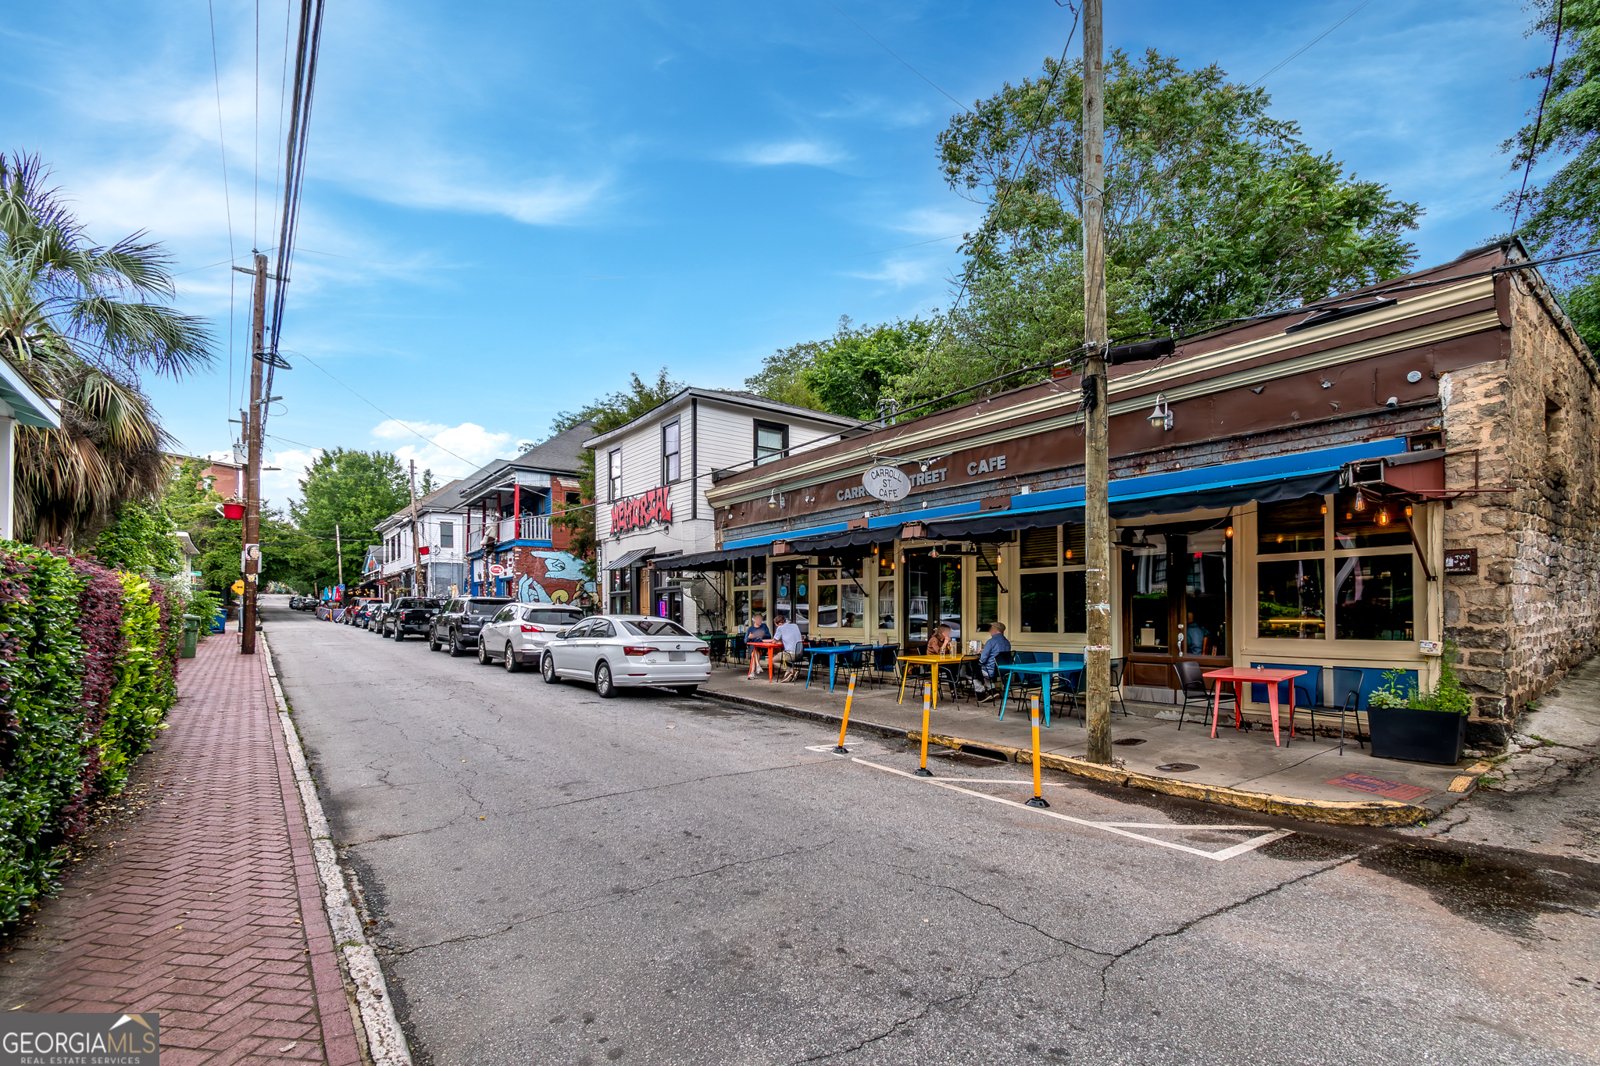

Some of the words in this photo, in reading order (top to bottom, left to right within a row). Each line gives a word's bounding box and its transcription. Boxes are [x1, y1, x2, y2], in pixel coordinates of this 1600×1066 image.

[836, 485, 870, 502] CARR
[909, 467, 948, 487] TREET
[966, 455, 1006, 476] CAFE
[871, 468, 902, 483] CARROLL
[609, 486, 673, 537] MEMORIAL
